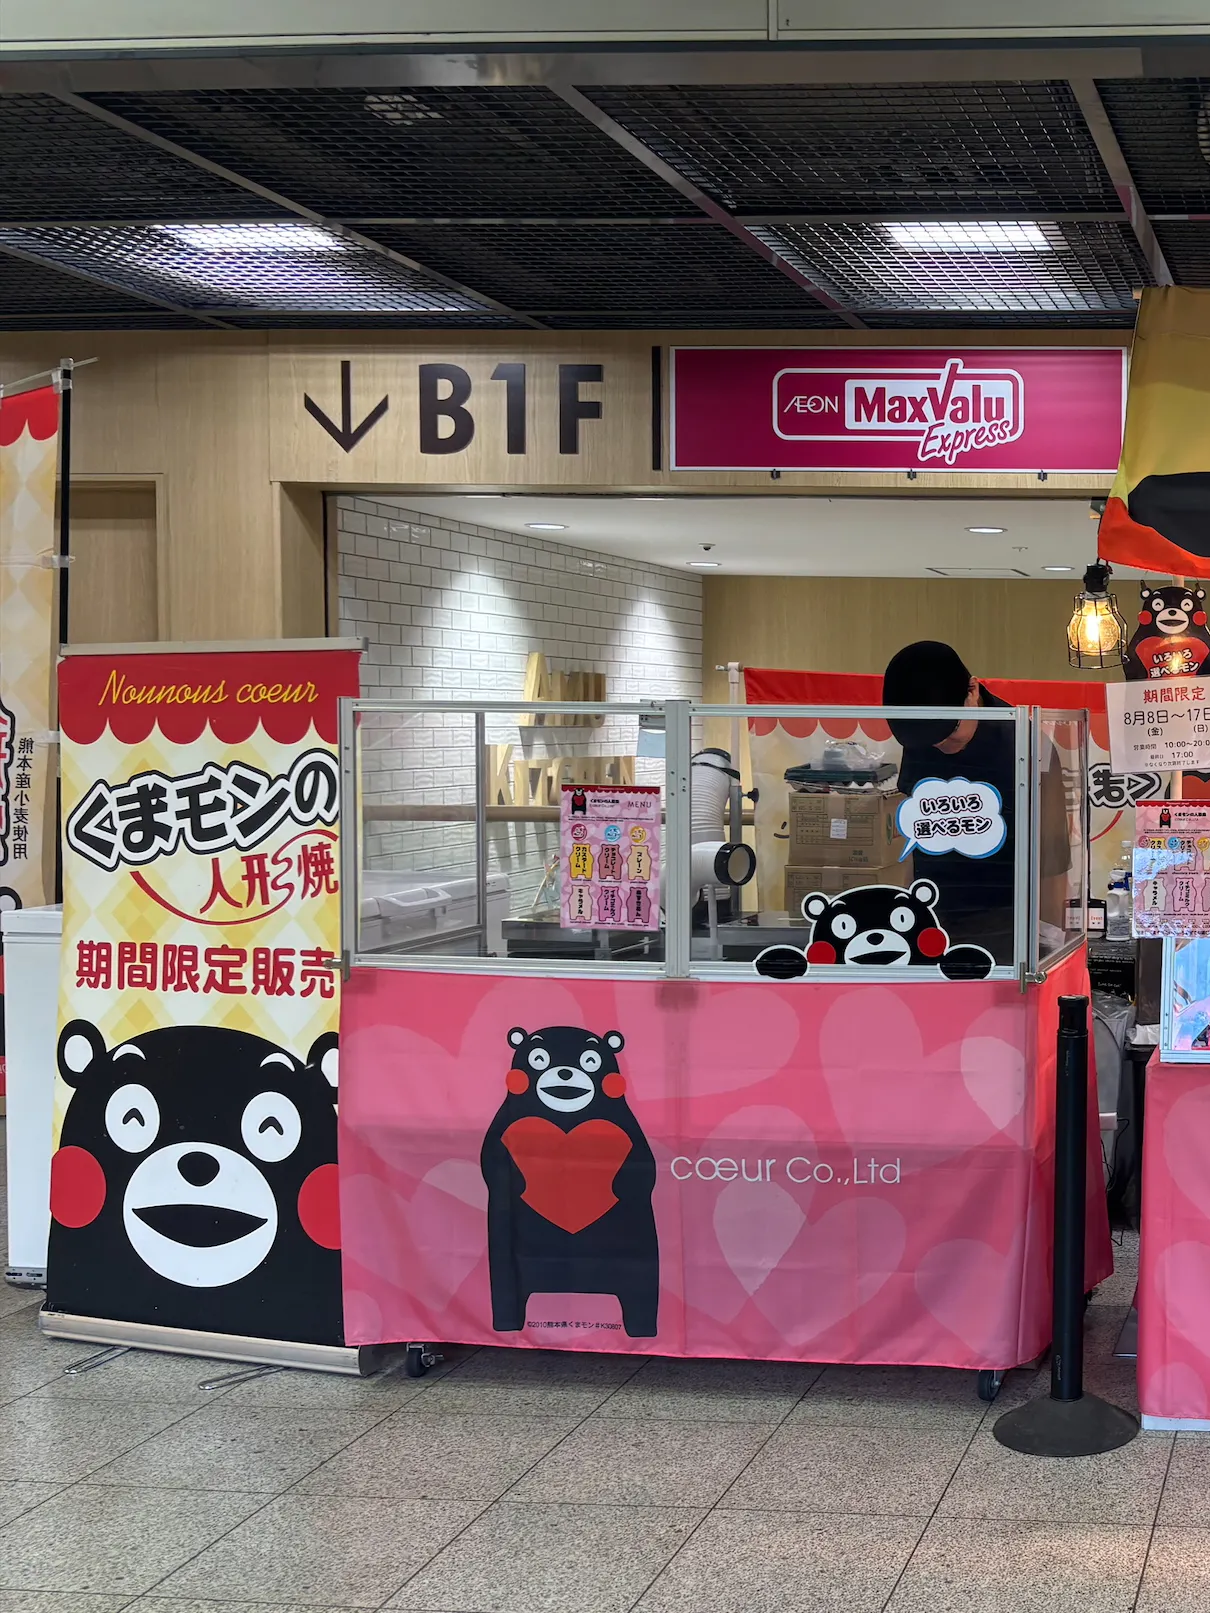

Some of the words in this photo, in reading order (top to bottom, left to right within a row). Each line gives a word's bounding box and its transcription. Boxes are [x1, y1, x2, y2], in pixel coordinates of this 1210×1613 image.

[854, 362, 1005, 424] MaxValu
[419, 363, 604, 455] B1F
[919, 419, 1011, 461] Express
[236, 681, 319, 703] coeur
[1143, 685, 1206, 704] 期間限定
[1193, 724, 1208, 733] (日)
[1171, 751, 1194, 759] 17:00
[68, 749, 338, 872] くまモンの
[627, 800, 652, 808] MENU
[921, 795, 983, 815] いろいろ
[914, 817, 992, 839] 選べるモン
[199, 840, 338, 915] 人形焼
[75, 939, 336, 998] 期間限定販売
